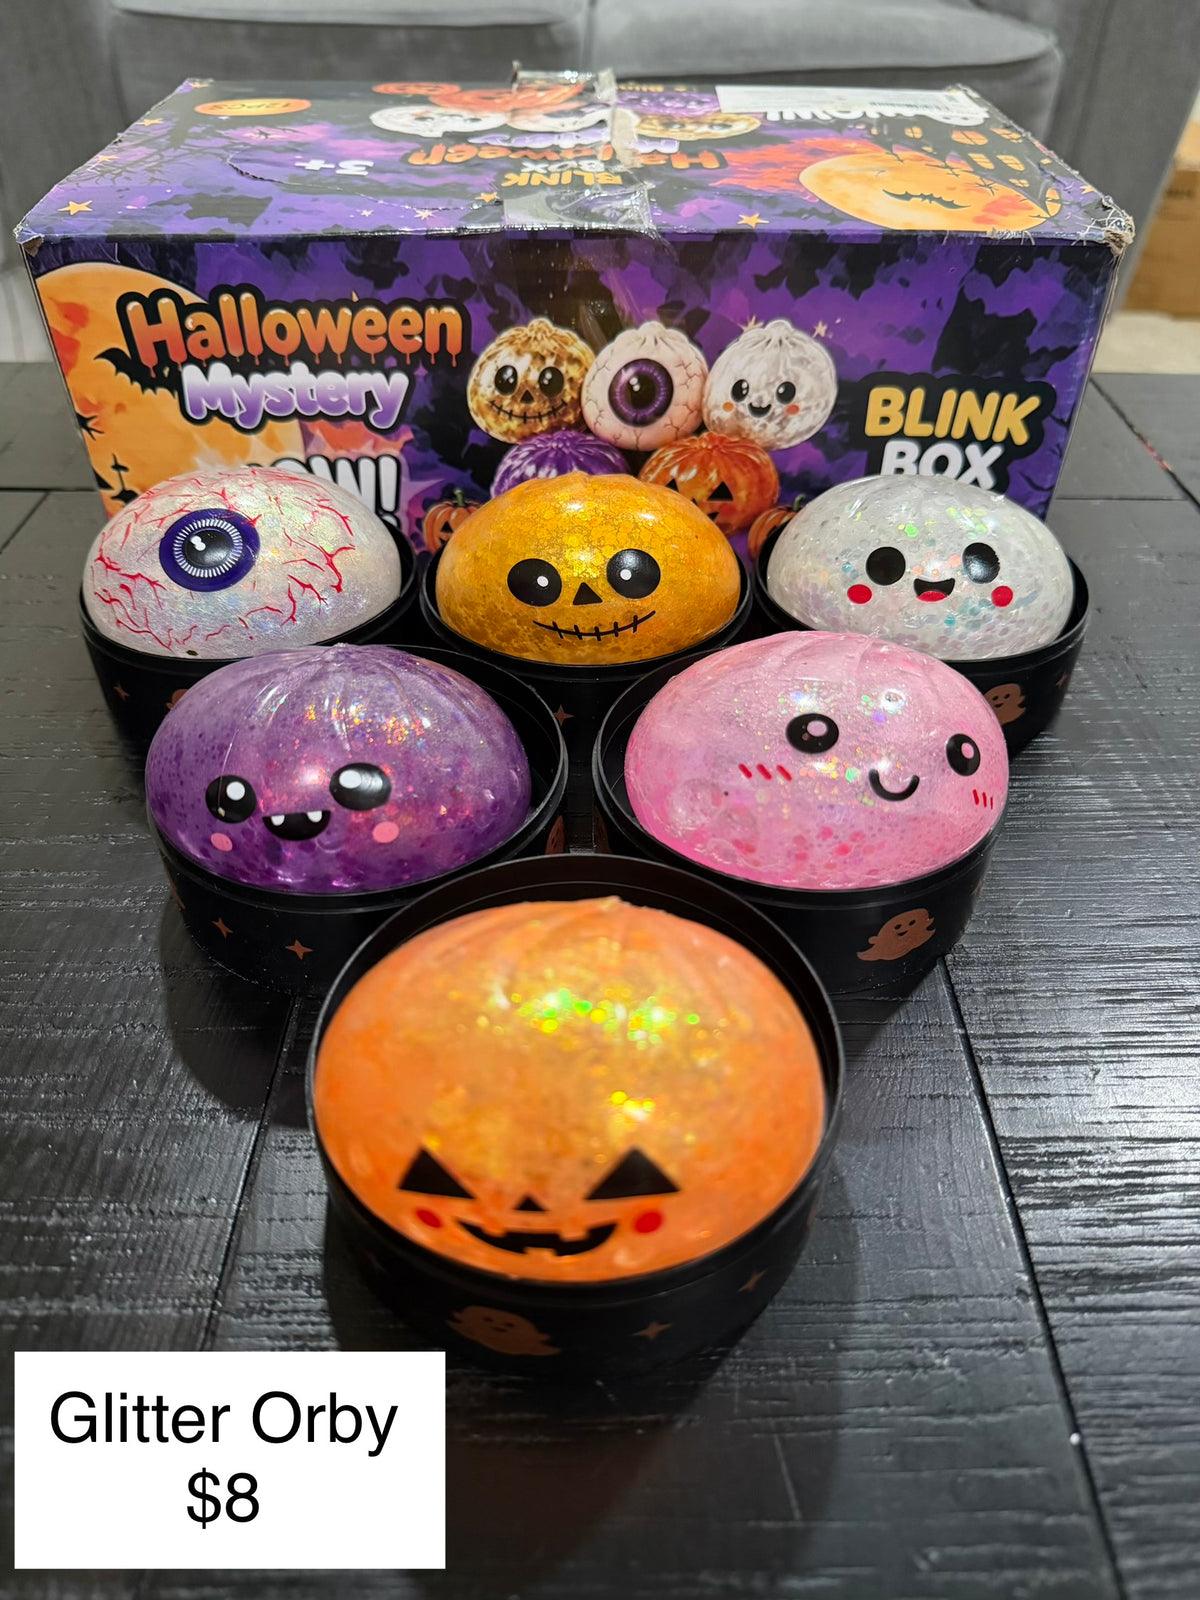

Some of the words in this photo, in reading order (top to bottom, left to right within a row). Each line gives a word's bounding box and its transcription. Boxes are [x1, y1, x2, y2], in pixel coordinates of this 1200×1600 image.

[500, 171, 623, 188] BLINK
[519, 160, 606, 174] BOX
[126, 292, 464, 378] Halloween
[181, 362, 411, 430] Mystery
[865, 387, 1041, 446] BLINK
[881, 439, 1004, 490] BOX
